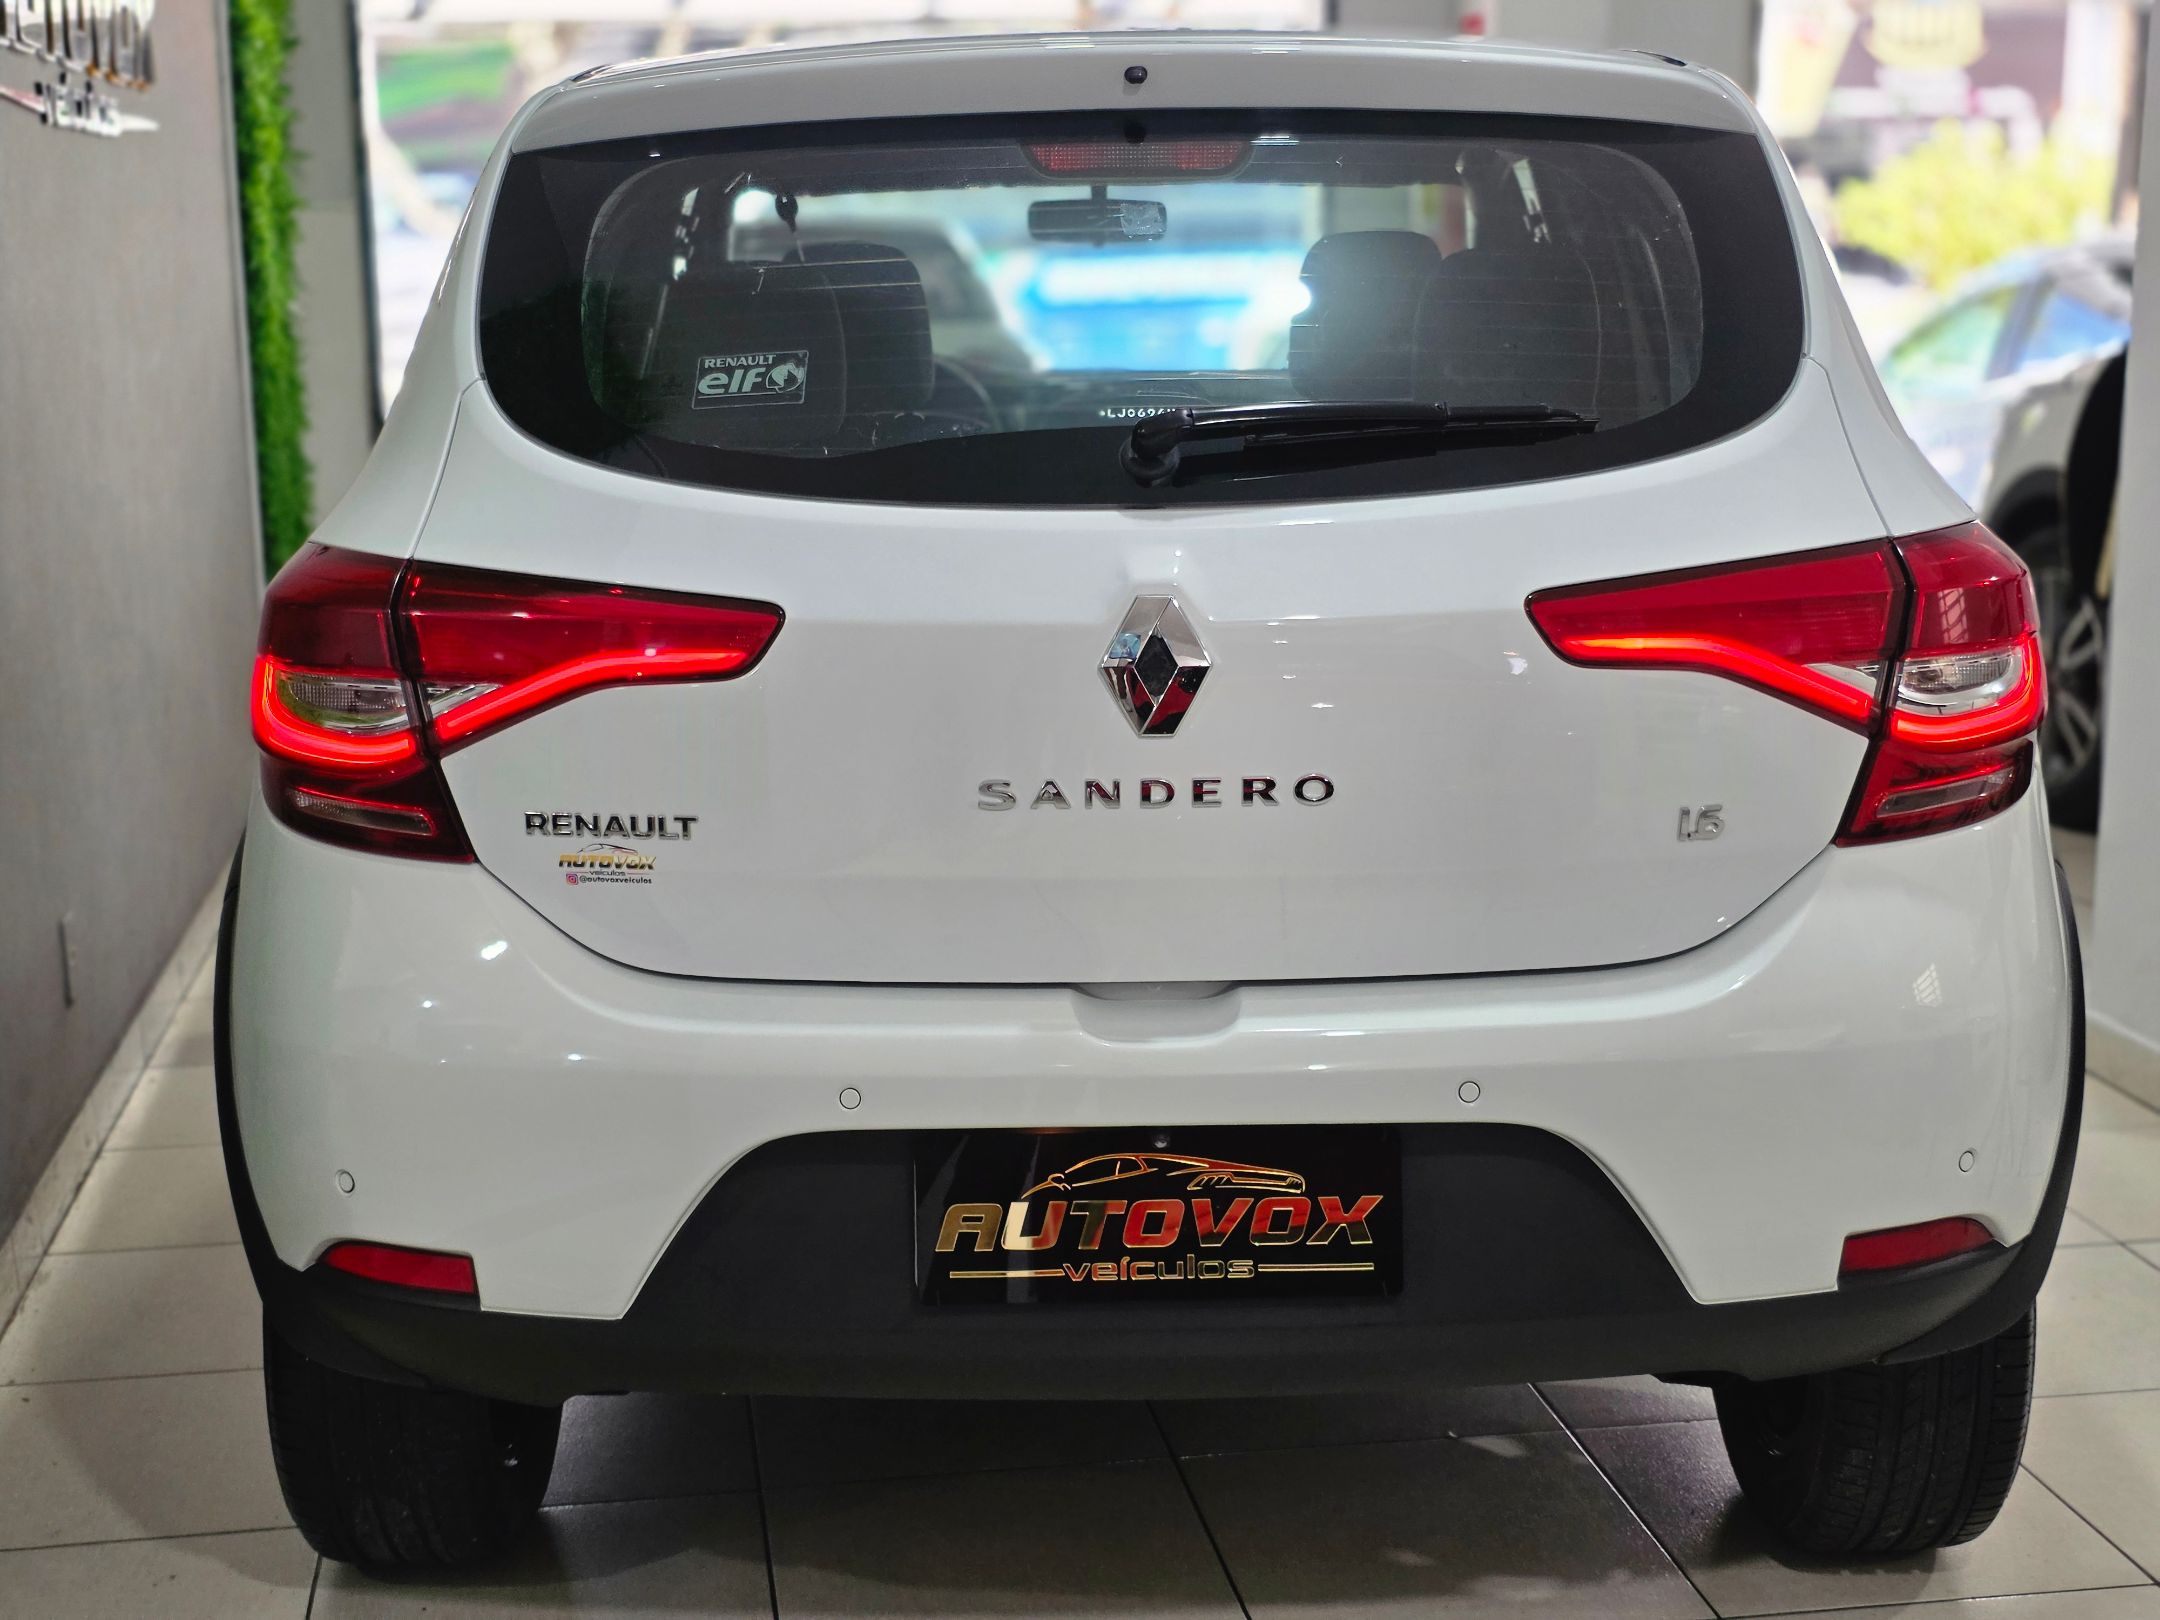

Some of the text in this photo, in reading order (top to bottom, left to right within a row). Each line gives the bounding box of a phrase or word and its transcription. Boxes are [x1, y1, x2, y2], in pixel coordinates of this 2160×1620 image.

[704, 354, 777, 369] RENAULT
[697, 367, 766, 395] elf
[971, 774, 1335, 811] SANDERO
[524, 811, 699, 840] RENAULT
[1677, 804, 1724, 842] 1.6
[558, 853, 657, 871] AUTOVOX
[935, 1195, 1384, 1252] AUTOVOX
[1062, 1253, 1256, 1283] veículos
